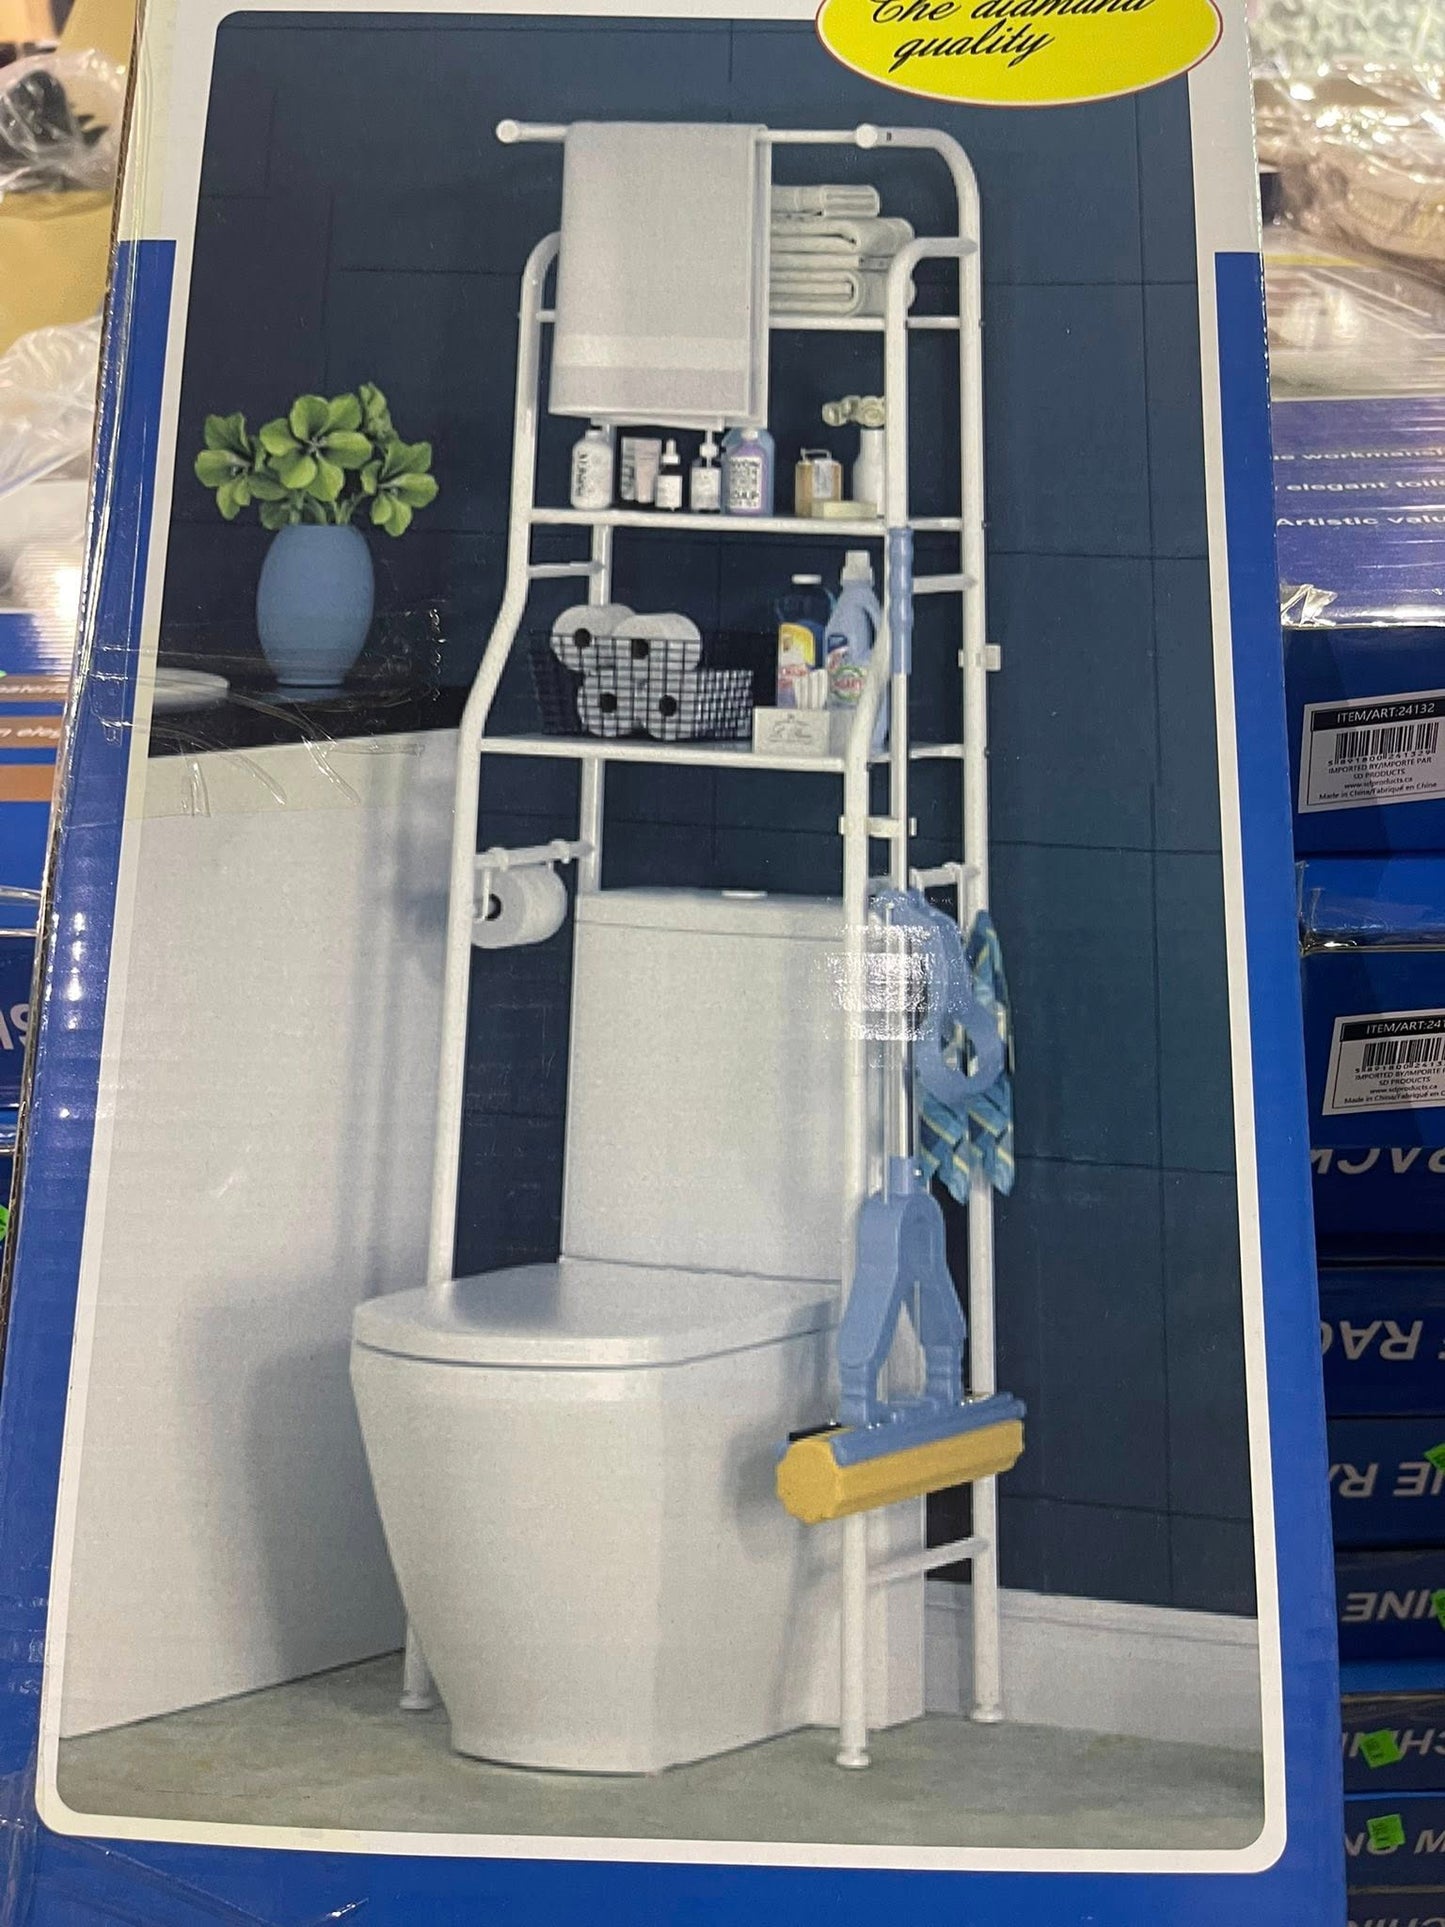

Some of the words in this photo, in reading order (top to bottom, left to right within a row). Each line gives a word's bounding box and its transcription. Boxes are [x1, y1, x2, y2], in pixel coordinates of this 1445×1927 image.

[888, 18, 1056, 74] quality
[1276, 517, 1379, 527] Artistic
[1337, 702, 1436, 724] ITEM/ART:24132
[1365, 768, 1406, 779] PRODUCTS
[1390, 1075, 1431, 1085] PRODUCTS
